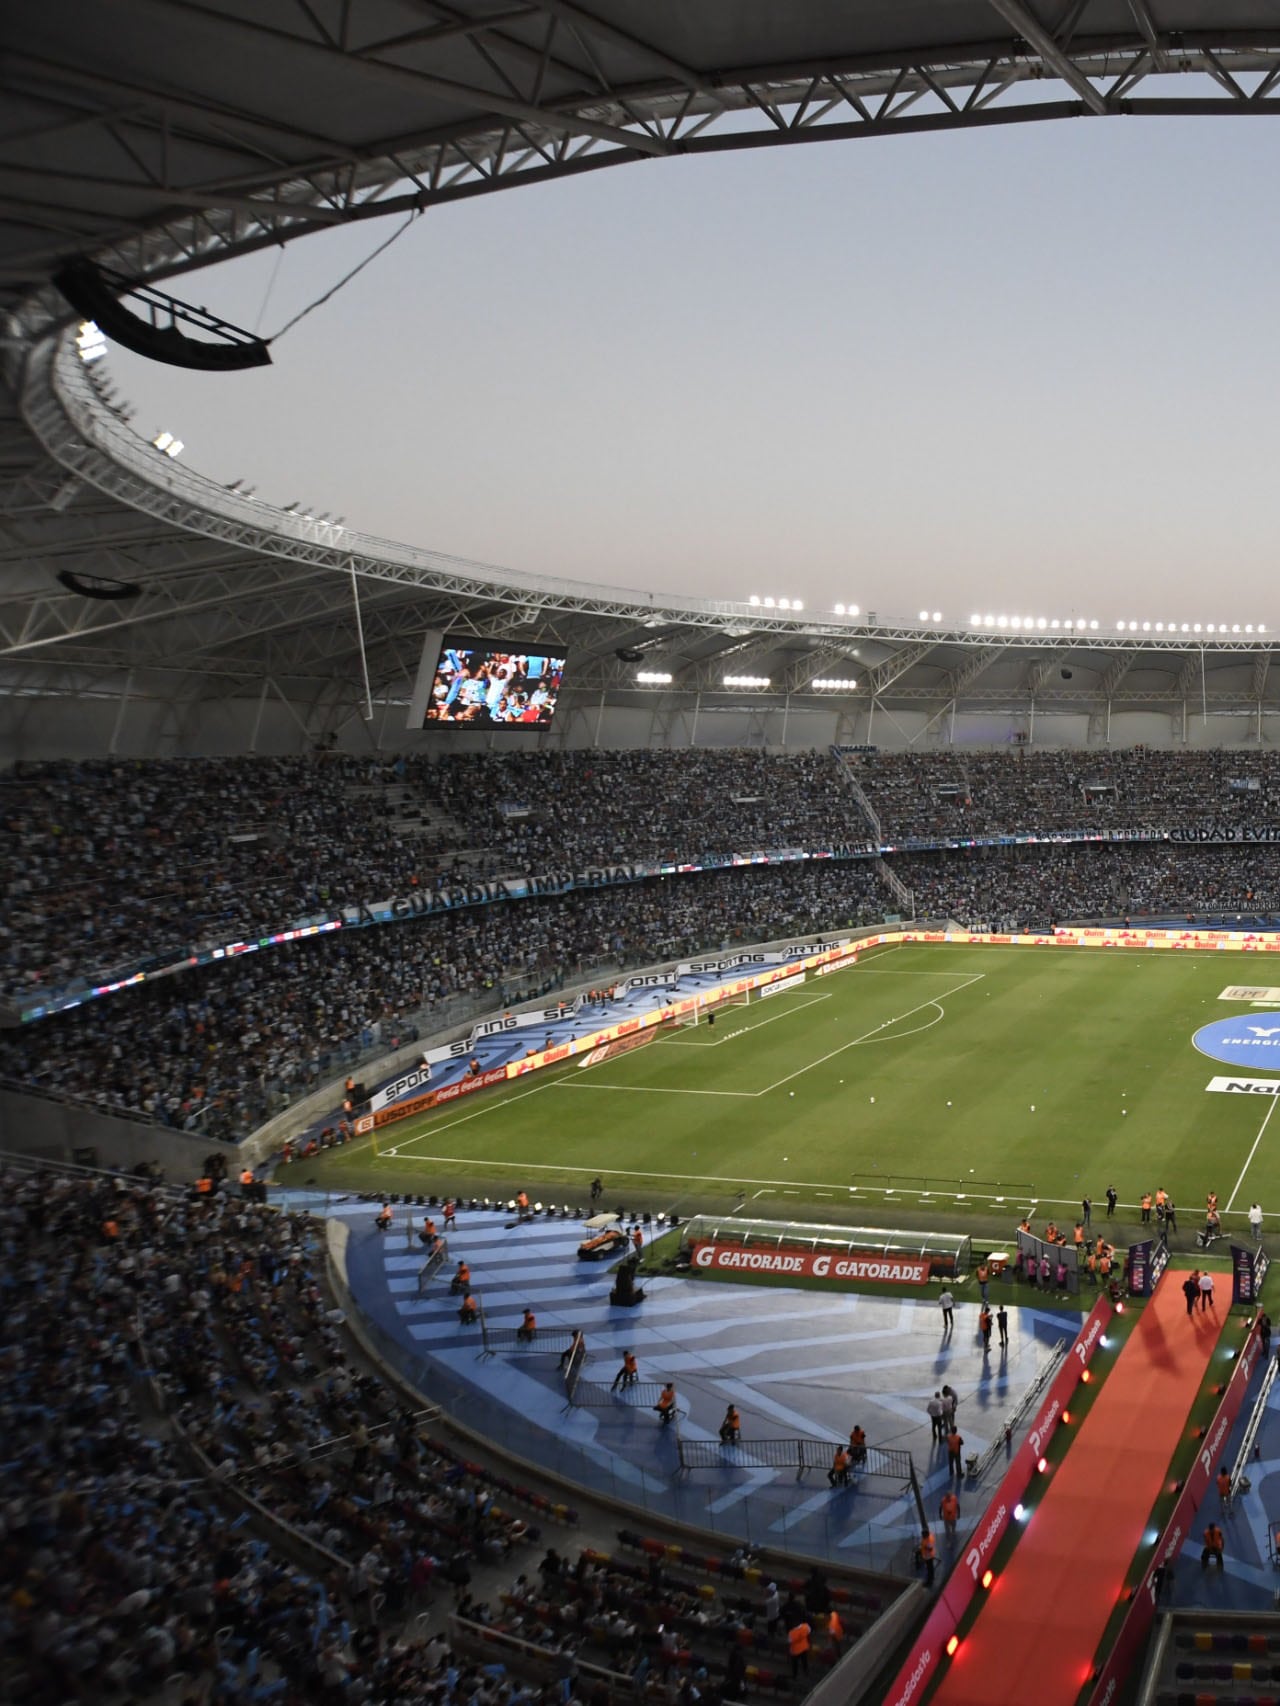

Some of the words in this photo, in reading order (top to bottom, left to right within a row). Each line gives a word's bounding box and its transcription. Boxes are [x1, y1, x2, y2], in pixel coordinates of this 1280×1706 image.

[1170, 828, 1235, 842] CIUDAD
[391, 880, 511, 918] GUARDIA
[527, 864, 641, 896] IMPERIAL
[690, 953, 765, 973] SPORTING
[385, 1067, 431, 1101] SPOR
[718, 1251, 804, 1272] GATORADE
[835, 1260, 924, 1281] GATORADE
[980, 1503, 1007, 1556] PedidosYa
